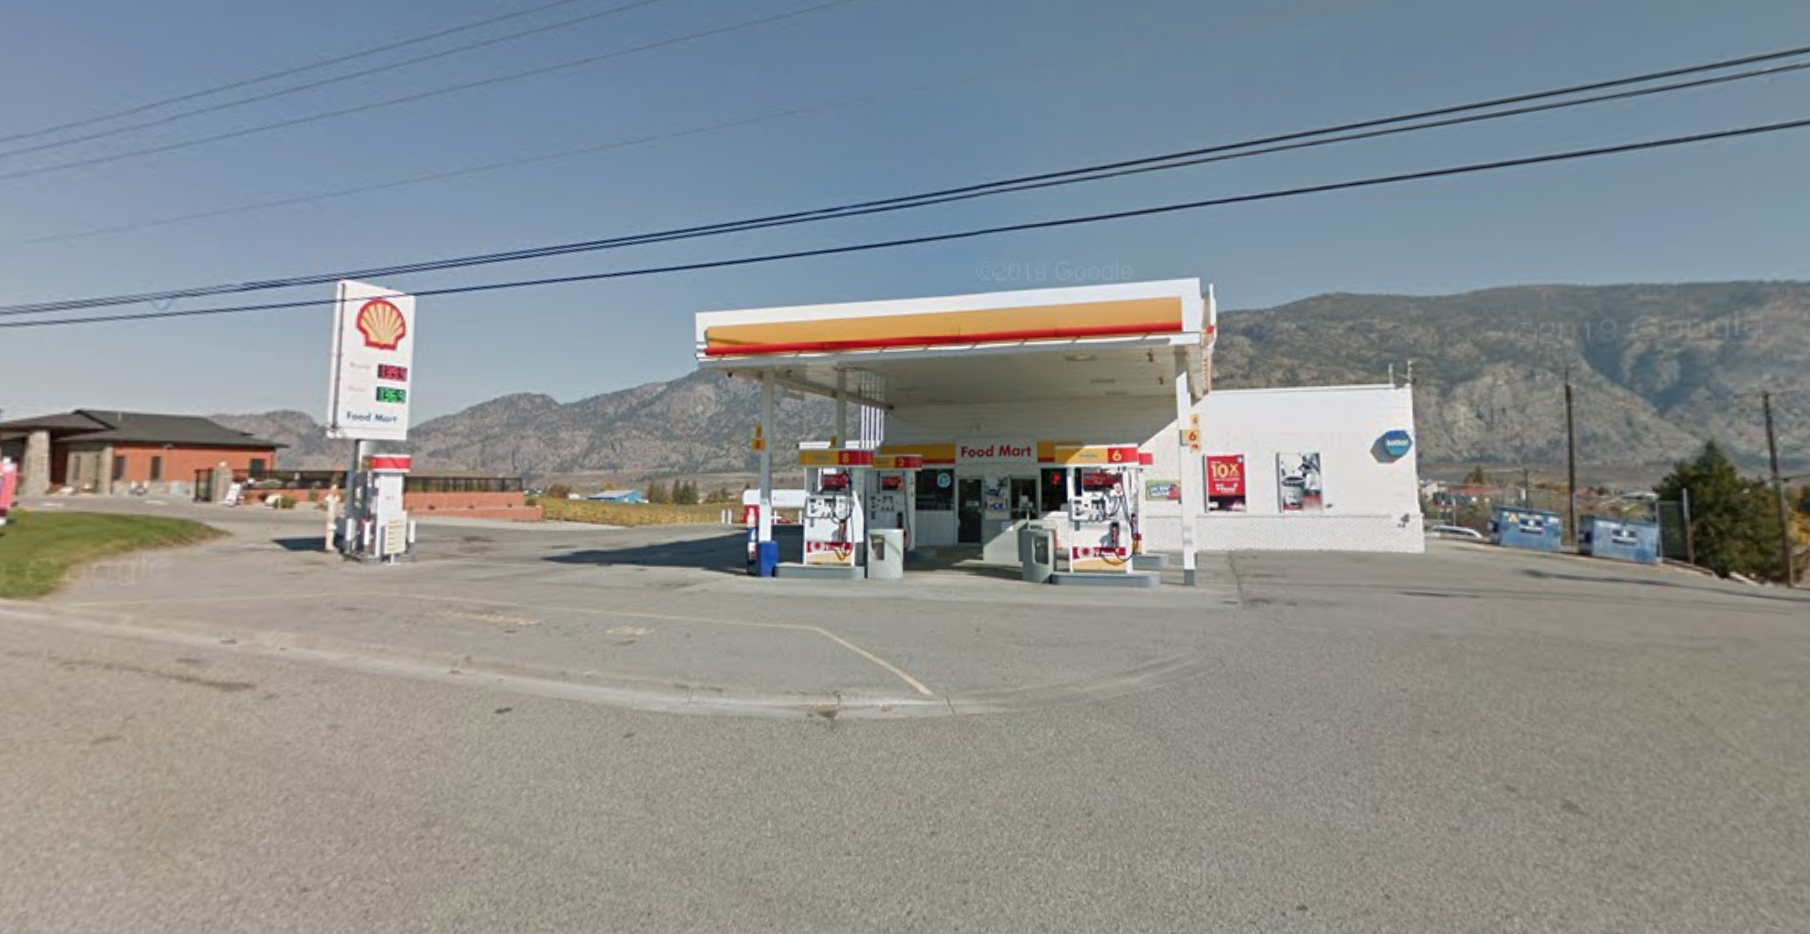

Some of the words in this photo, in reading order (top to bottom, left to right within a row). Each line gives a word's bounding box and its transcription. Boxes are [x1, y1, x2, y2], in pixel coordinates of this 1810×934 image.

[347, 411, 371, 422] Food
[375, 413, 397, 423] Mart
[1188, 431, 1197, 441] 6
[960, 445, 994, 458] Food
[999, 444, 1031, 457] Mart
[1112, 450, 1123, 462] 6
[842, 452, 850, 464] 8
[898, 458, 906, 468] 2
